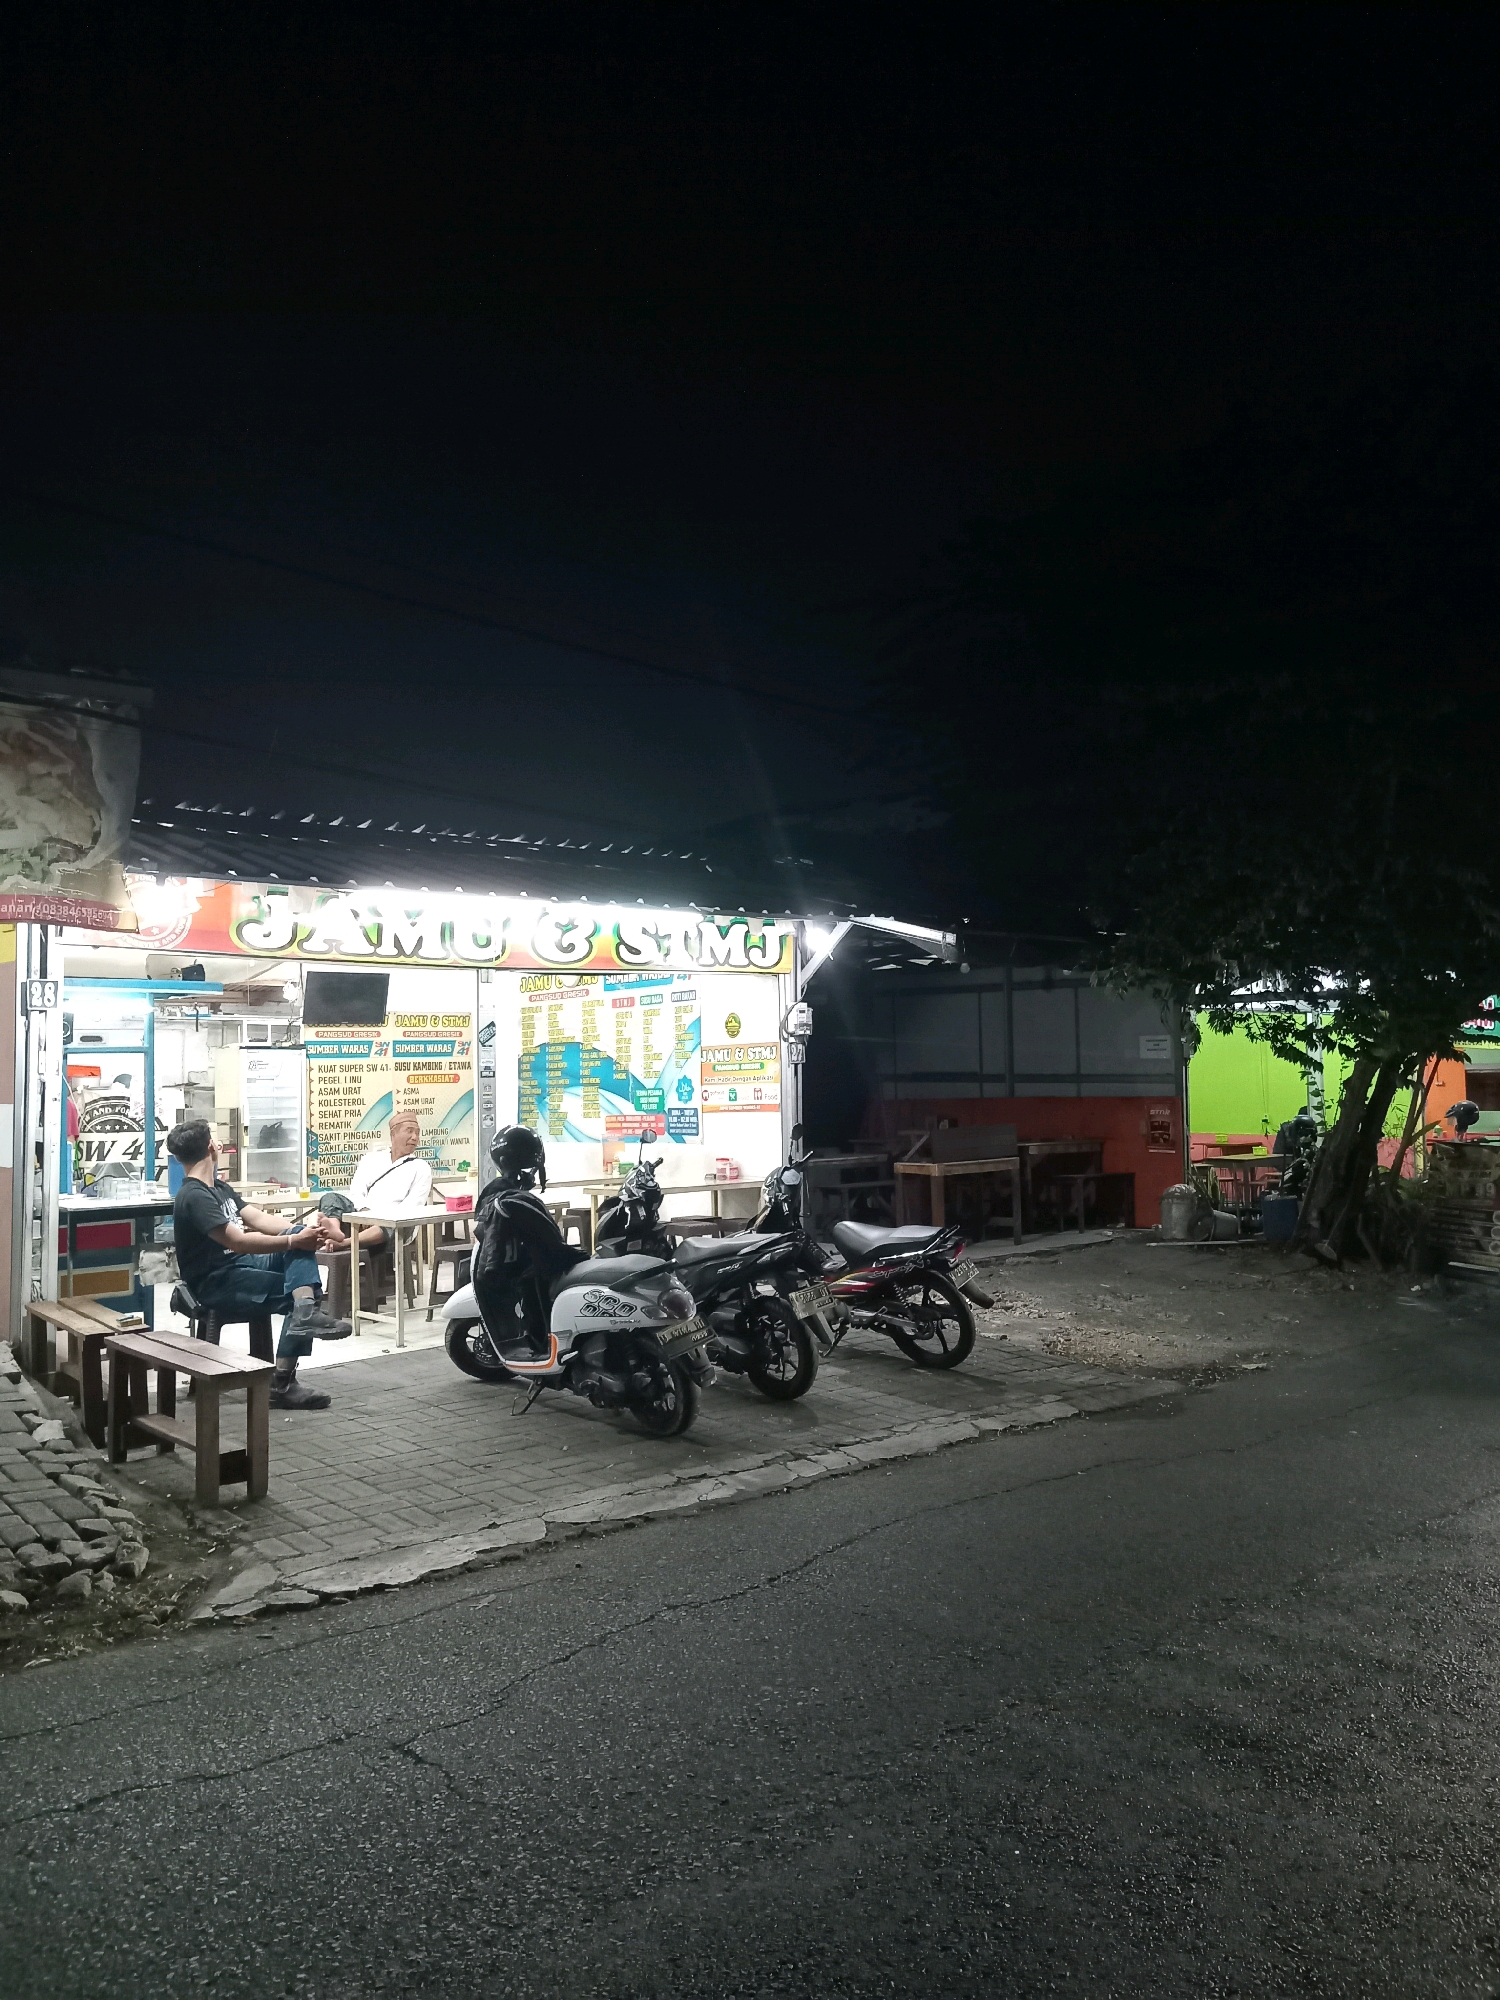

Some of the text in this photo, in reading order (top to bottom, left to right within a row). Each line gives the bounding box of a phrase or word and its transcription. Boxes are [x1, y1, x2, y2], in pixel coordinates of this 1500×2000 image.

[234, 888, 507, 963] JAMU
[531, 905, 598, 966] &
[520, 975, 552, 993] JAMU
[31, 981, 56, 1008] 28
[395, 1014, 471, 1028] JAMU & STMJ
[307, 1044, 369, 1054] SUMBER WARAS
[374, 1048, 389, 1057] 41
[395, 1043, 452, 1053] SUMBER WARAS
[456, 1047, 470, 1056] 41
[701, 1045, 778, 1063] JAMU & STMJ
[318, 1064, 337, 1073] KUAT
[339, 1063, 364, 1073] SUPER
[366, 1063, 378, 1073] SW
[394, 1061, 411, 1071] SUSU
[412, 1061, 443, 1071] KAMBING
[448, 1061, 472, 1070] ETAWA
[318, 1076, 341, 1084] PEGEL
[409, 1074, 455, 1084] BERKHASIAT
[318, 1086, 361, 1096] ASAM URAT
[403, 1087, 420, 1095] ASMA
[318, 1098, 367, 1107] KOLESTEROL
[403, 1097, 436, 1106] ASAM URAT
[93, 1107, 112, 1118] AND
[318, 1109, 362, 1119] SEHAT PRIA
[318, 1121, 352, 1130] REMATIK
[318, 1130, 382, 1142] SAKIT PINGGANG
[421, 1127, 449, 1137] LAMBUNG
[449, 1137, 470, 1146] WANITA
[319, 1143, 369, 1153] SAKIT ENCOK
[319, 1155, 347, 1165] MASUK
[440, 1158, 456, 1167] KULIT
[319, 1167, 344, 1176] BATUK
